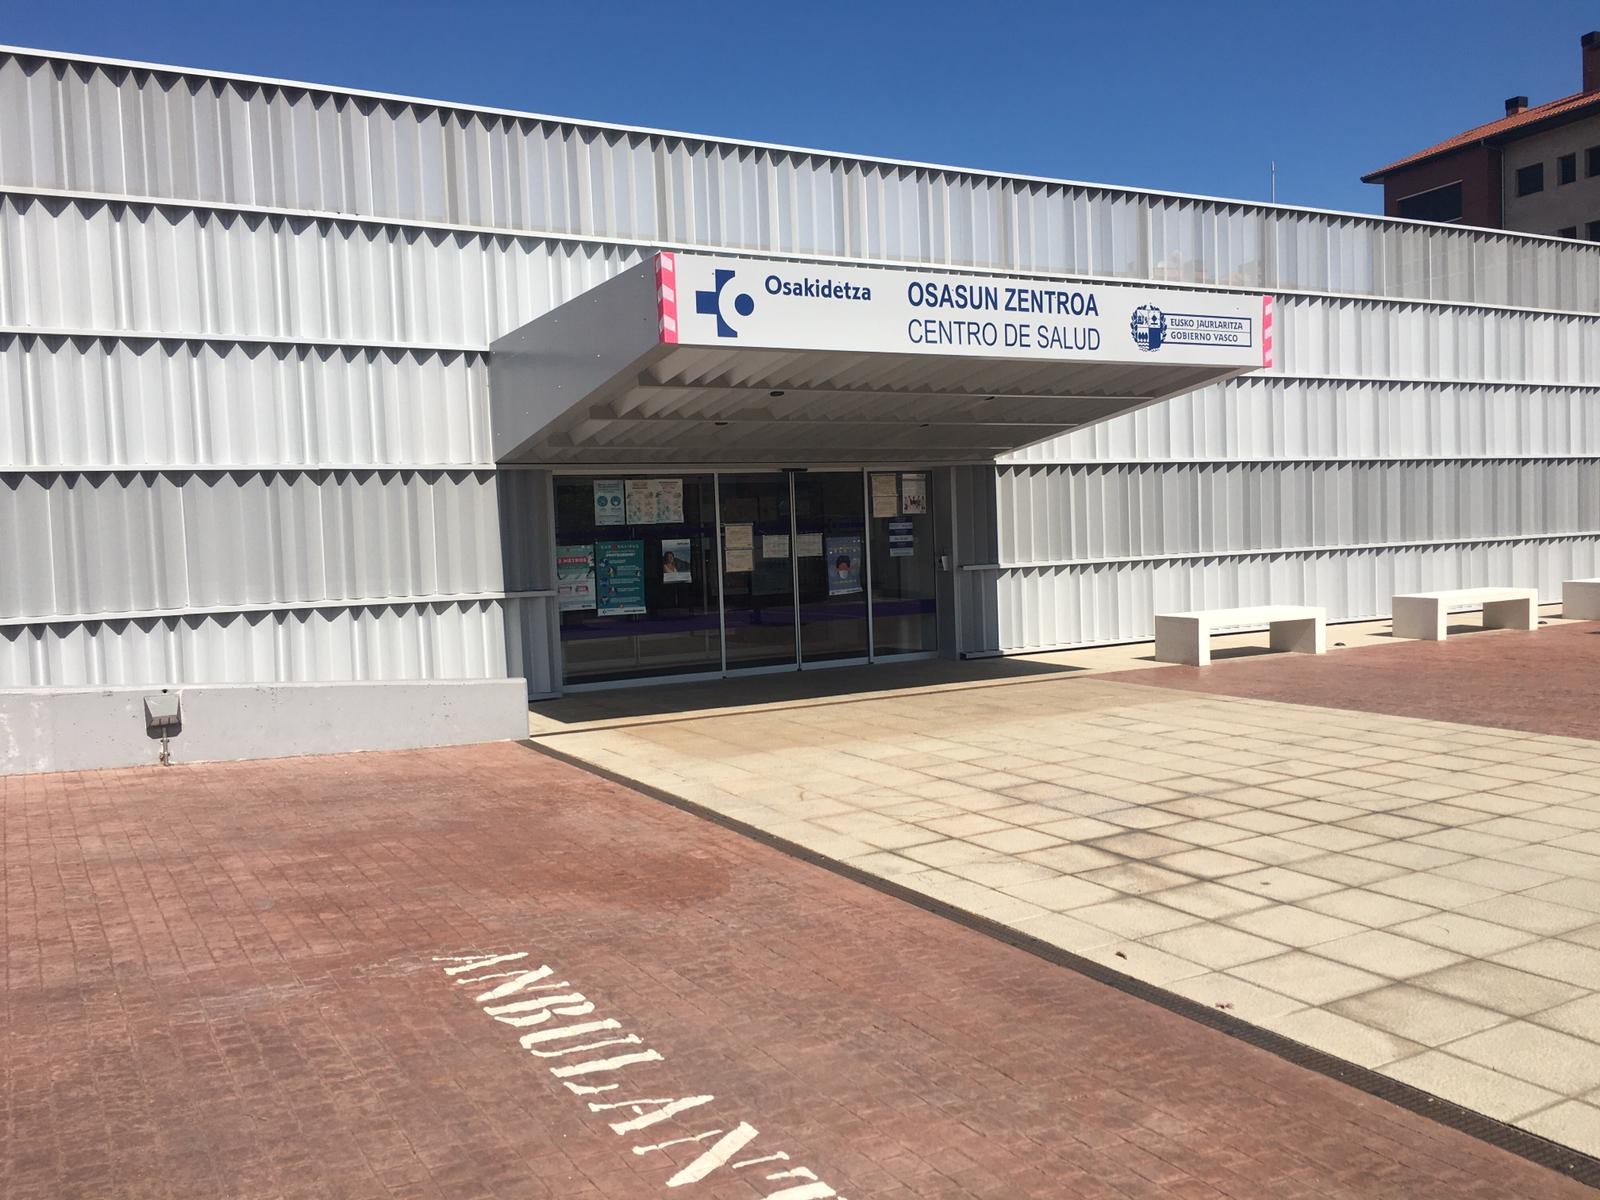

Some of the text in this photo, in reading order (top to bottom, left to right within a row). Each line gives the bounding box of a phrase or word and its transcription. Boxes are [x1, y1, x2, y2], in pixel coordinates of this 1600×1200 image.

[764, 274, 872, 301] Osakidetza
[907, 281, 1099, 317] OSASUN ZENTROA
[907, 318, 1101, 351] CENTRO DE SALUD
[1170, 318, 1243, 330] EUSKO JAURLARITZA
[1170, 331, 1238, 343] GOBIERNO VASCO
